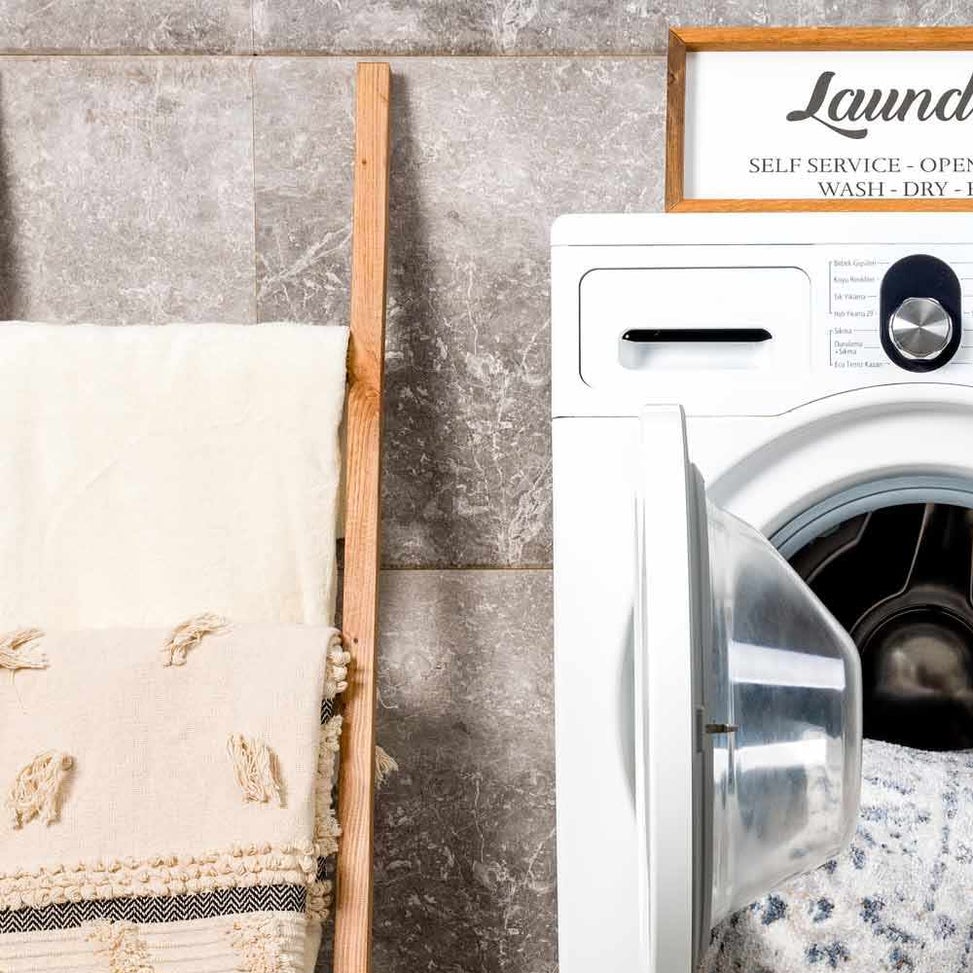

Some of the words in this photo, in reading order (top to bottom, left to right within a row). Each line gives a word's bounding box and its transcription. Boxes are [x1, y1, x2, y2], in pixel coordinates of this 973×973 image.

[749, 157, 802, 173] SELF
[807, 157, 901, 173] SERVICE
[818, 181, 884, 197] WASH
[903, 181, 948, 197] DRY
